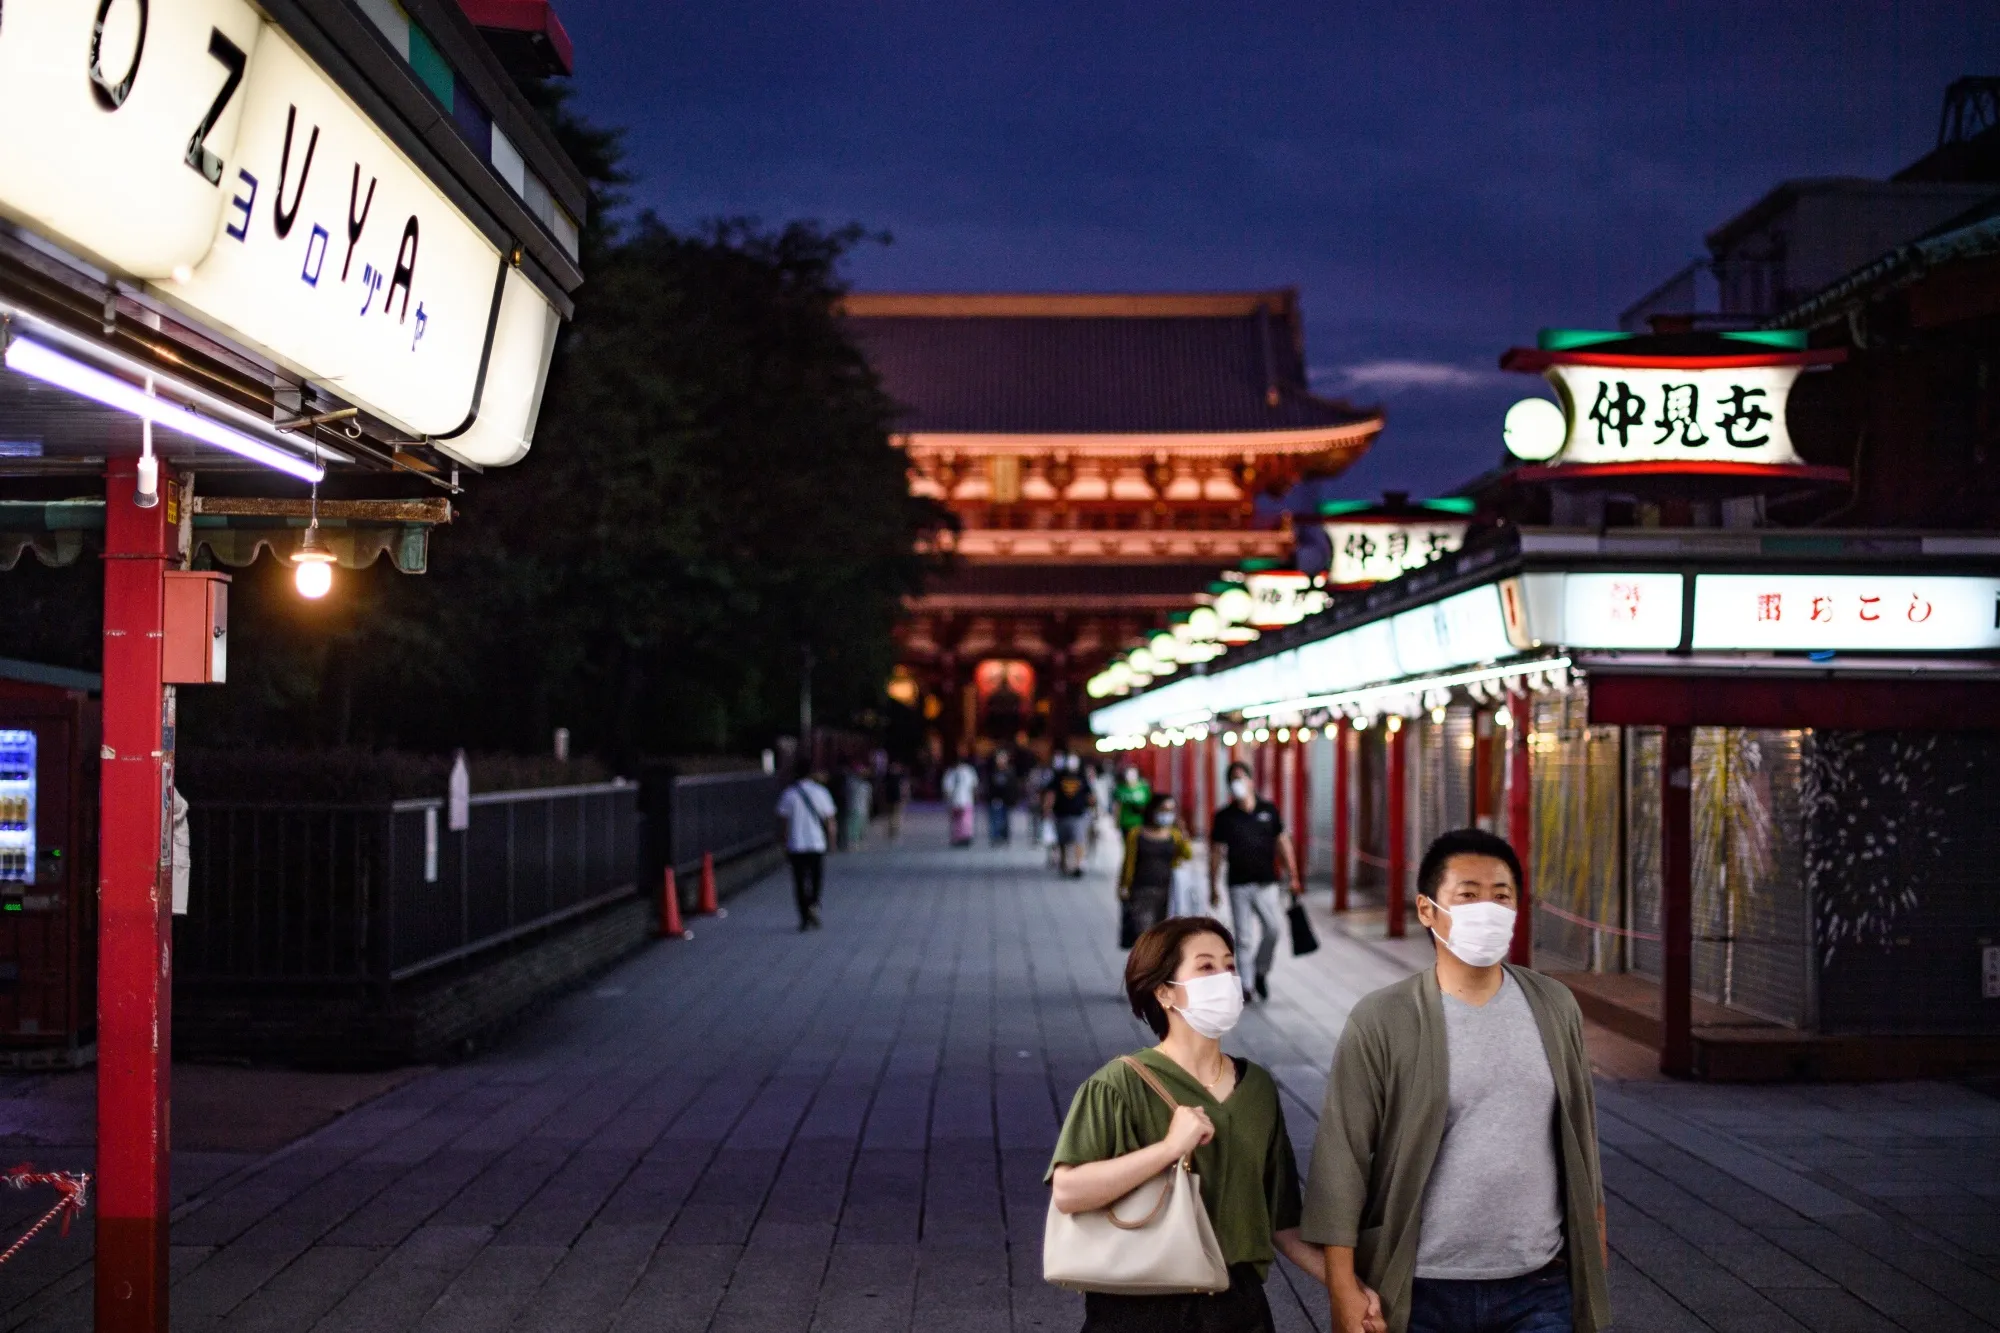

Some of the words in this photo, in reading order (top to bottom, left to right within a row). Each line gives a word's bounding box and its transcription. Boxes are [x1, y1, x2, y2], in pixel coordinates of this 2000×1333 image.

[0, 0, 419, 325] OZUYA
[1588, 380, 1773, 448] 仲見世
